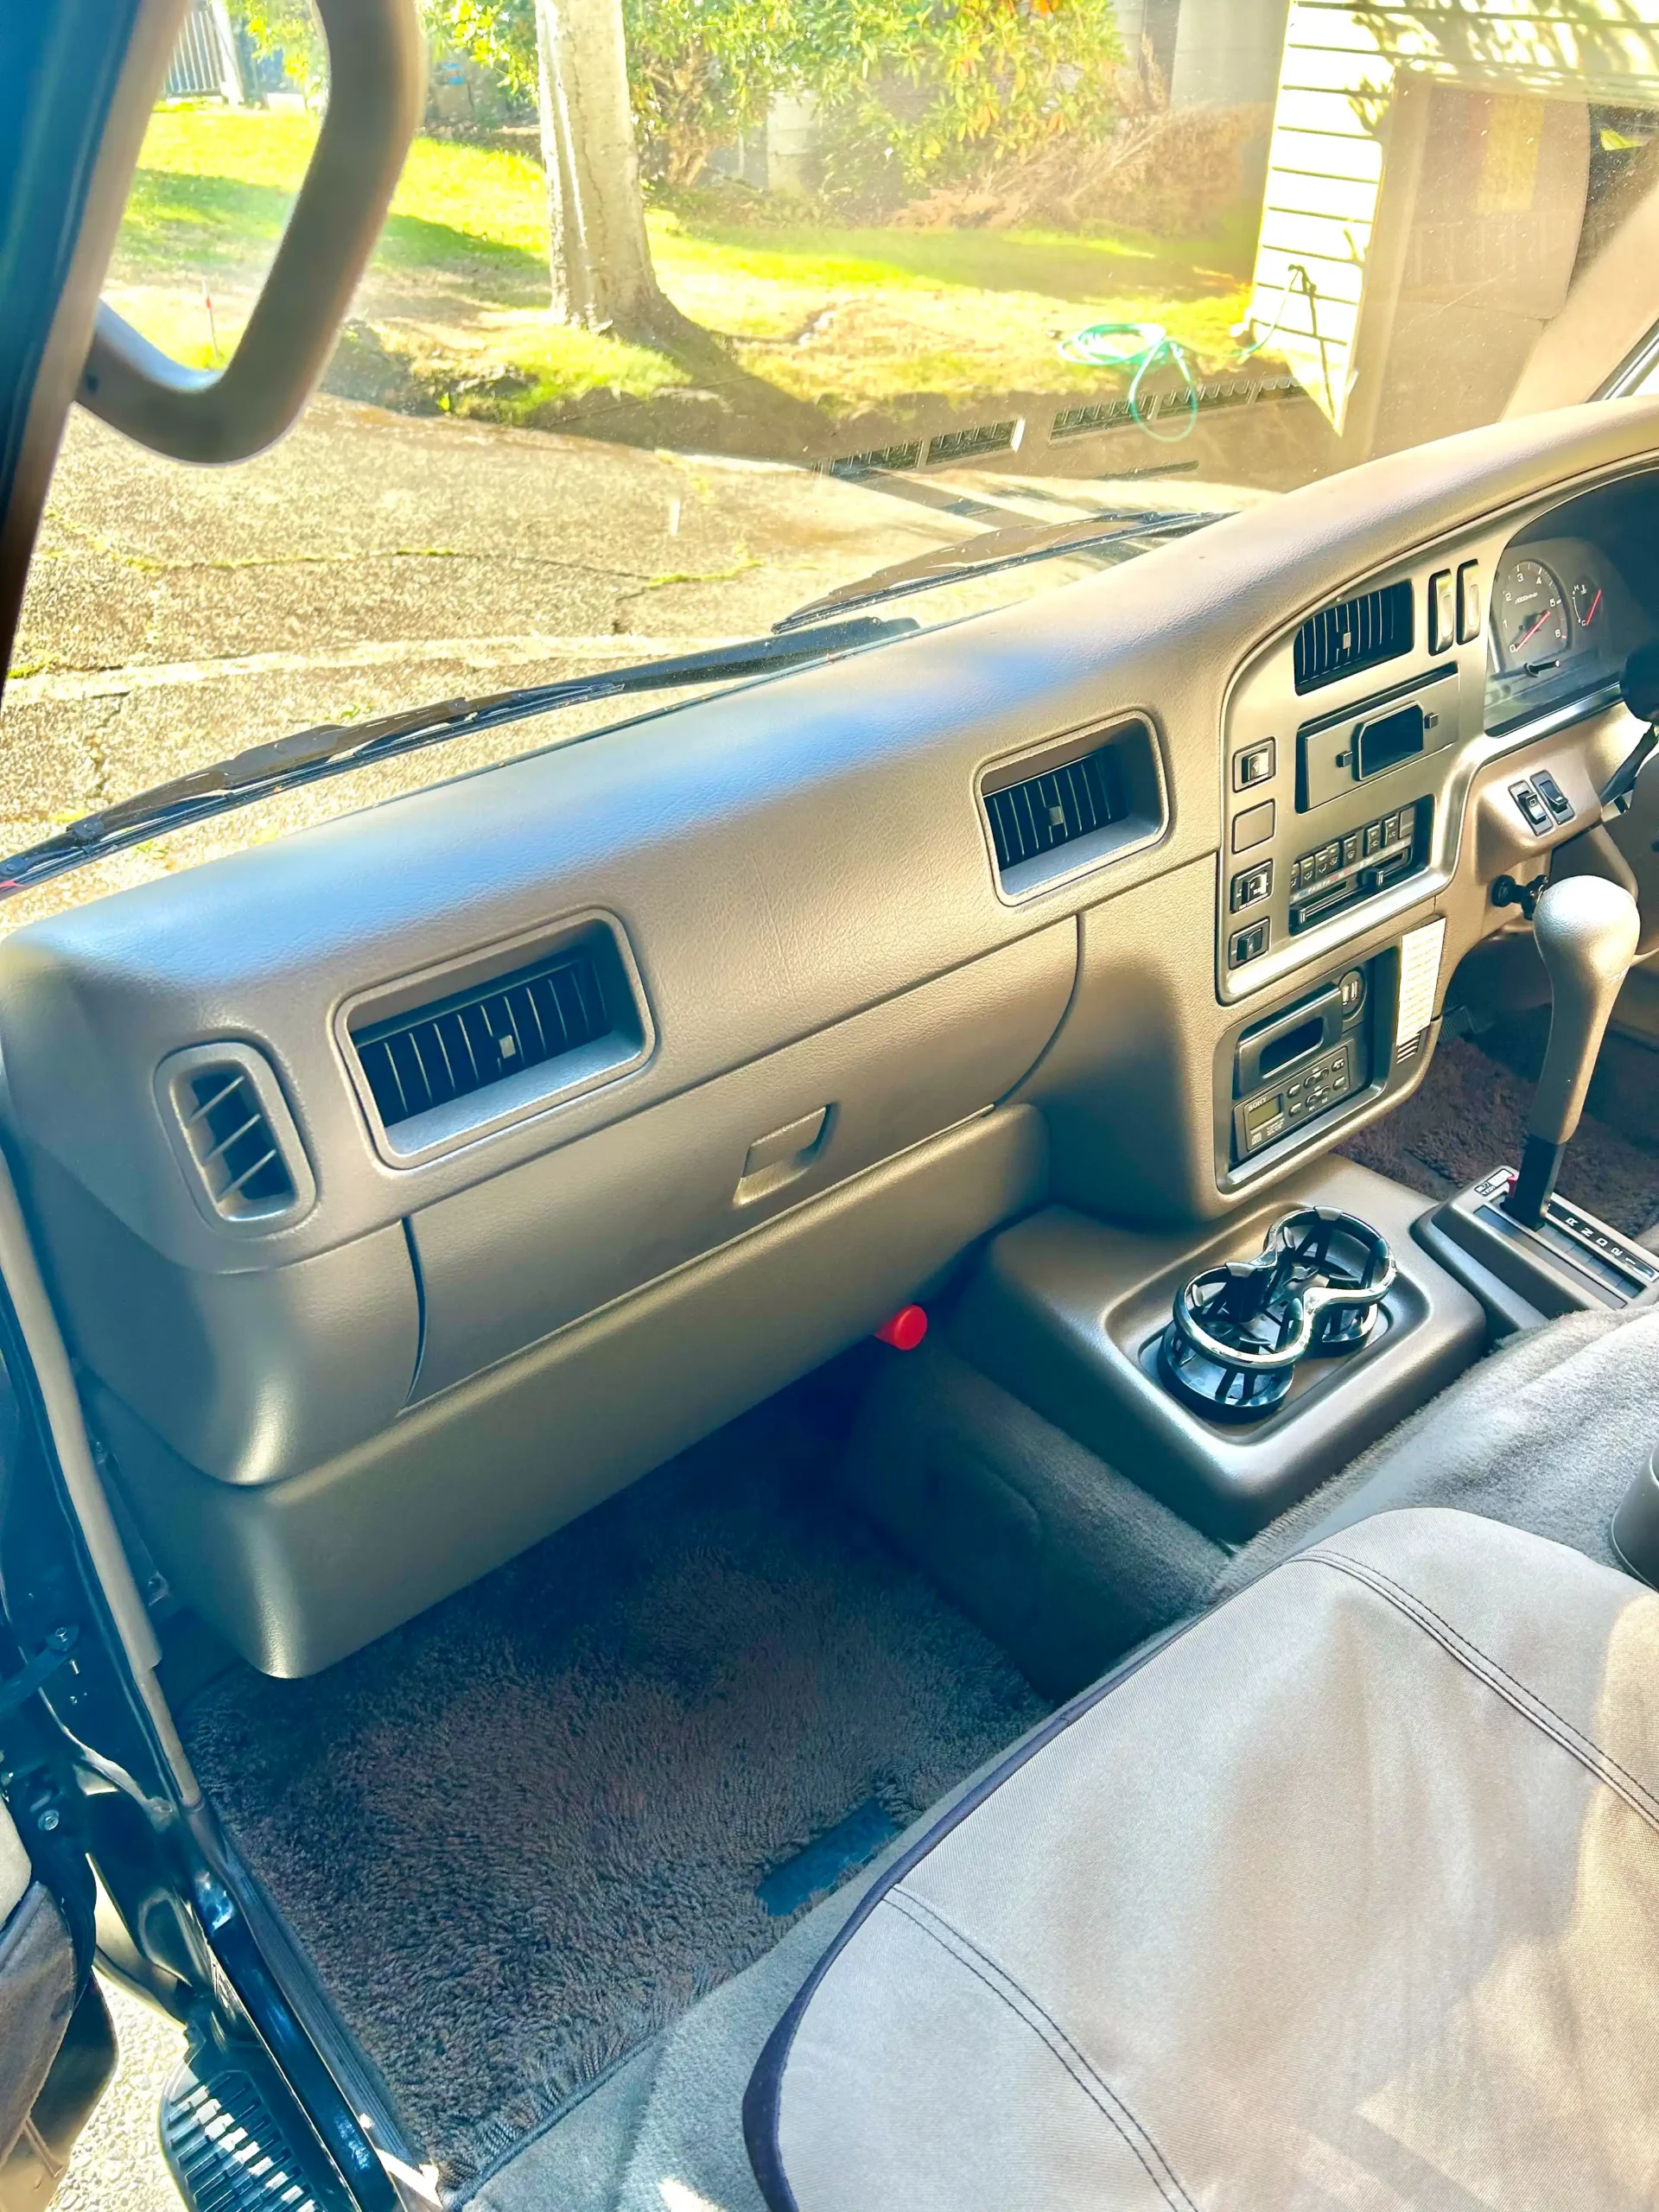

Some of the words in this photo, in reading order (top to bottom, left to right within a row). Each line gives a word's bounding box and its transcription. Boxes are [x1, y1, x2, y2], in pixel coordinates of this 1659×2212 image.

[1505, 593, 1511, 601] 2
[1549, 598, 1555, 607] 5
[1249, 1097, 1267, 1110] SONY
[1580, 1227, 1593, 1236] N
[1611, 1247, 1623, 1256] 2
